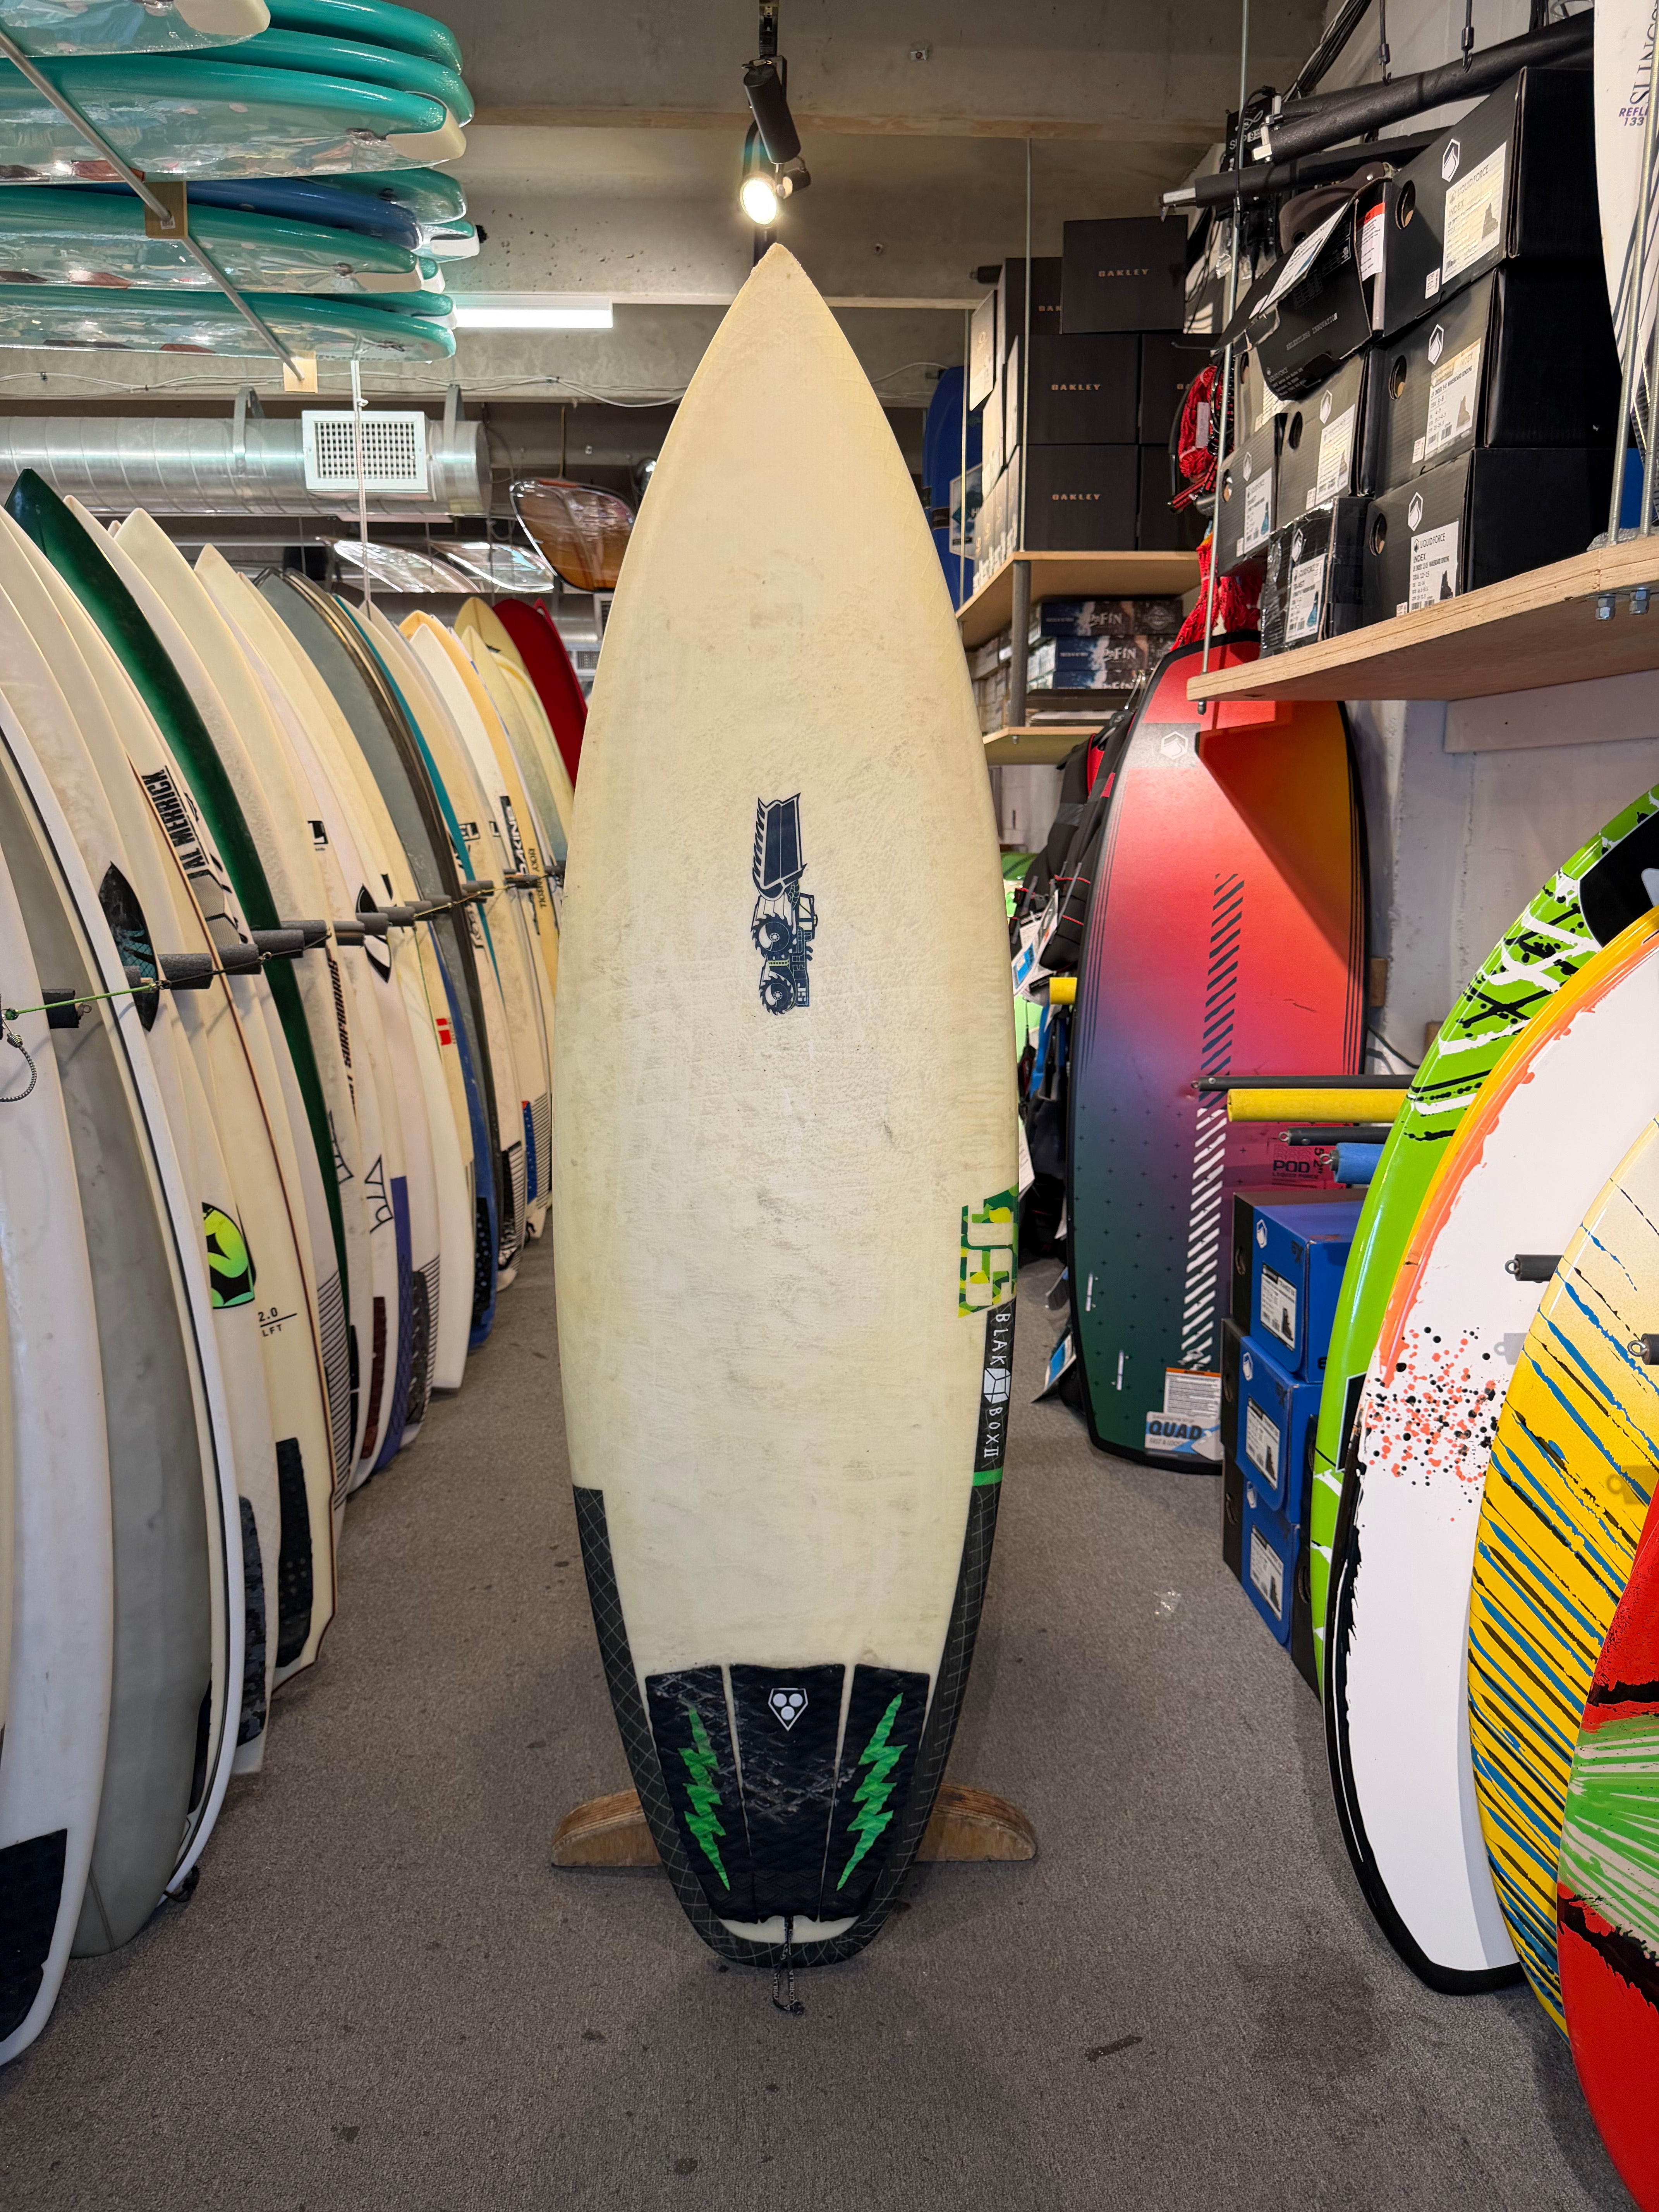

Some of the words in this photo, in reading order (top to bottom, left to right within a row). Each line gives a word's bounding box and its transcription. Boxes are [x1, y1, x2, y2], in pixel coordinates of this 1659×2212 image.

[1619, 106, 1647, 117] REFL
[1624, 117, 1644, 126] 133
[1473, 164, 1489, 185] FORCE
[1449, 199, 1464, 217] INDEX
[1097, 268, 1149, 277] OAKLEY
[1420, 537, 1432, 548] LIQUID
[1433, 533, 1445, 544] FORCE
[1413, 553, 1426, 563] INDEX
[141, 769, 195, 847] MERRICK
[179, 848, 206, 870] AL
[537, 880, 547, 908] ARROLL
[797, 983, 806, 1001] JS
[328, 960, 351, 1069] SURFBOARDS
[1273, 1160, 1310, 1173] POD
[258, 1307, 278, 1322] 2.0
[262, 1324, 283, 1337] LFT
[991, 1313, 1011, 1365] BLAK
[1149, 1420, 1202, 1440] QUAD
